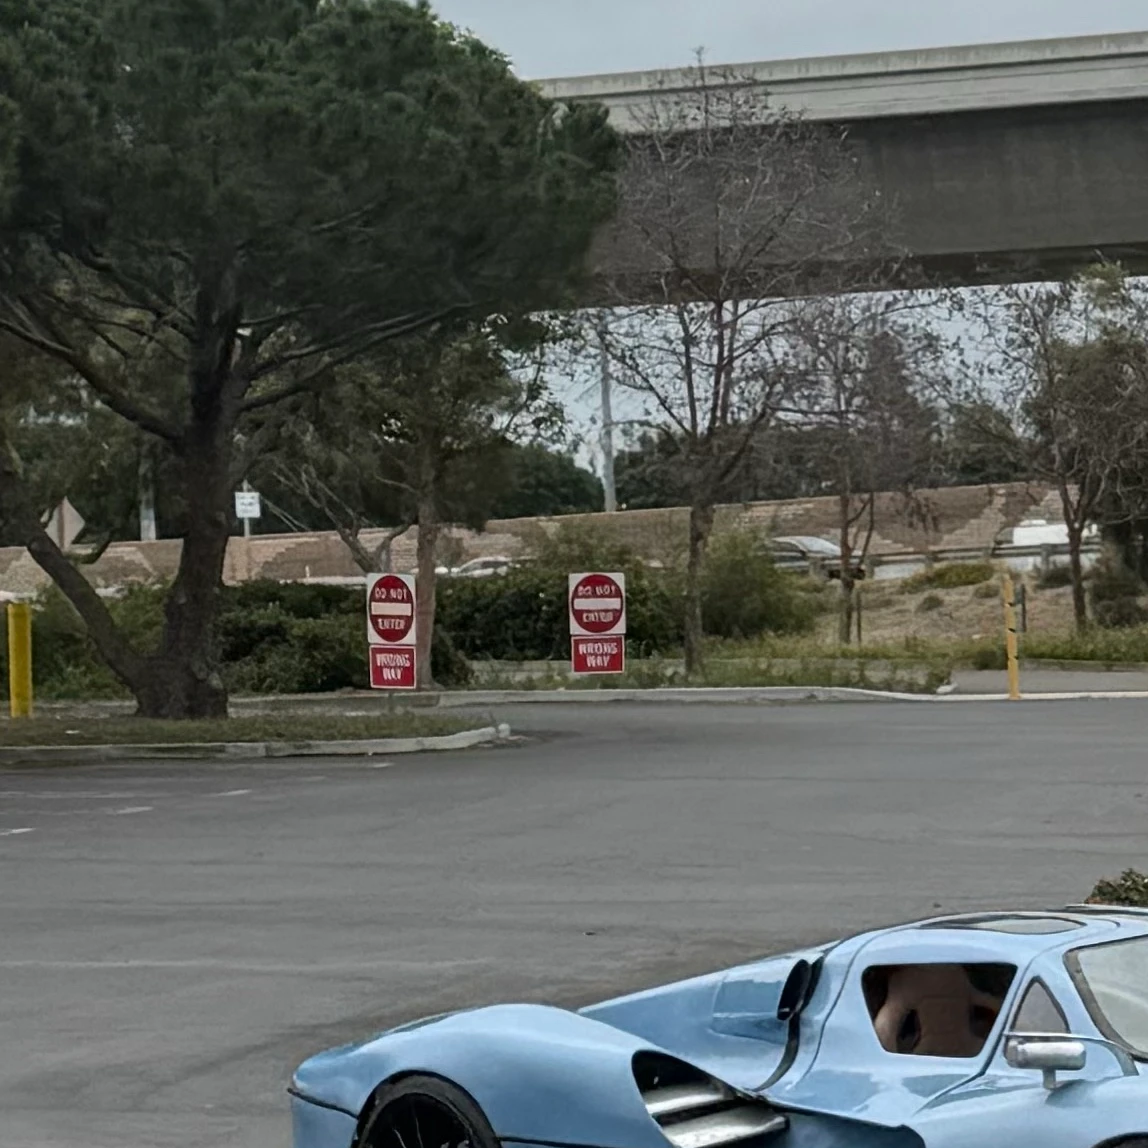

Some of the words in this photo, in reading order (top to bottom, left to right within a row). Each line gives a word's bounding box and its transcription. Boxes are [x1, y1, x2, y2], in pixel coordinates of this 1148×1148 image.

[375, 587, 387, 599] DO
[390, 588, 407, 600] NOT
[378, 618, 405, 630] ENTER
[586, 655, 610, 668] WAY
